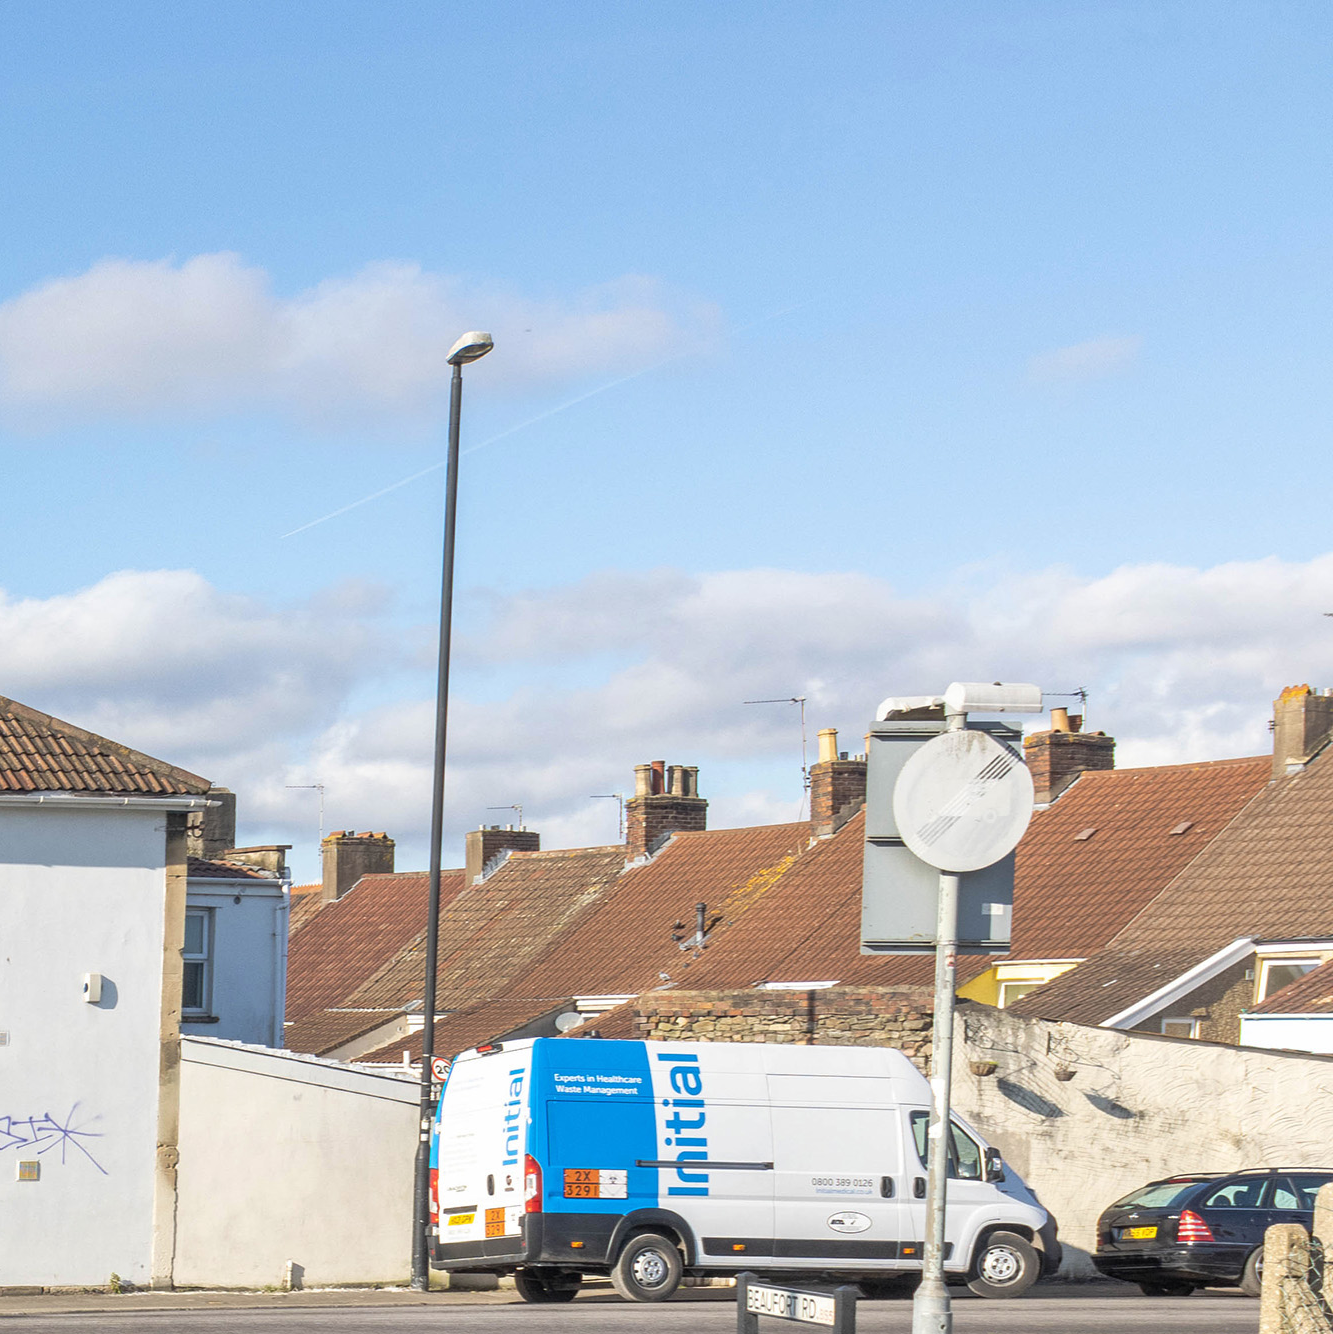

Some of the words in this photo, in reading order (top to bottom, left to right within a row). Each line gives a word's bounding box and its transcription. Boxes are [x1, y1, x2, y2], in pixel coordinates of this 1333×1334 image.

[554, 1073, 585, 1083] Experts
[596, 1075, 642, 1084] Healthcare
[555, 1085, 582, 1093] Waste
[583, 1086, 638, 1095] Management
[502, 1068, 525, 1166] Initial
[657, 1053, 709, 1197] Initial
[575, 1171, 591, 1181] 2X
[812, 1178, 833, 1187] 0800
[836, 1178, 851, 1187] 389
[853, 1179, 873, 1188] 0126
[566, 1185, 598, 1196] 3291
[747, 1289, 798, 1316] BEAUFORT
